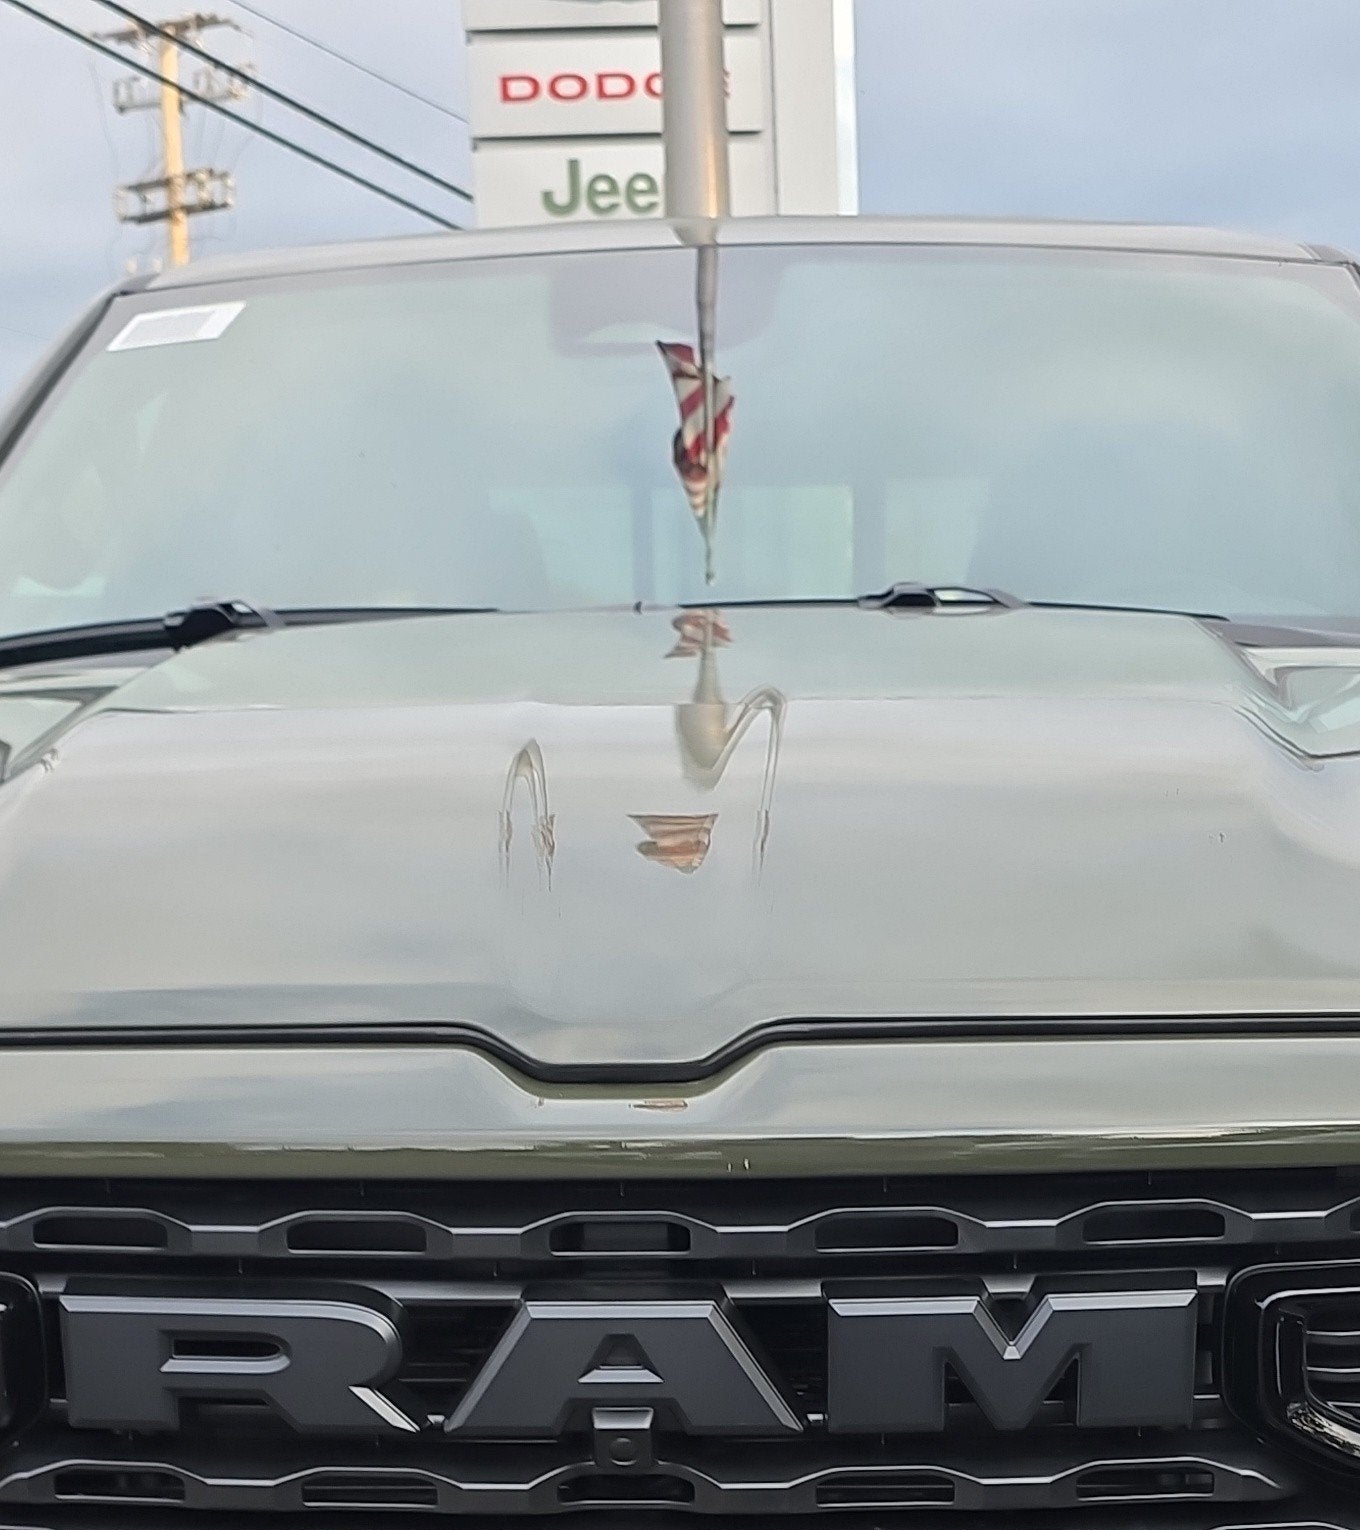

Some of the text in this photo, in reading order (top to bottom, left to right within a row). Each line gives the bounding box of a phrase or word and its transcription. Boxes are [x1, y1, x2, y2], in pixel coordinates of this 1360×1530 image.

[499, 72, 731, 103] DOD
[542, 158, 660, 218] Jee
[58, 1288, 1199, 1436] RAM
